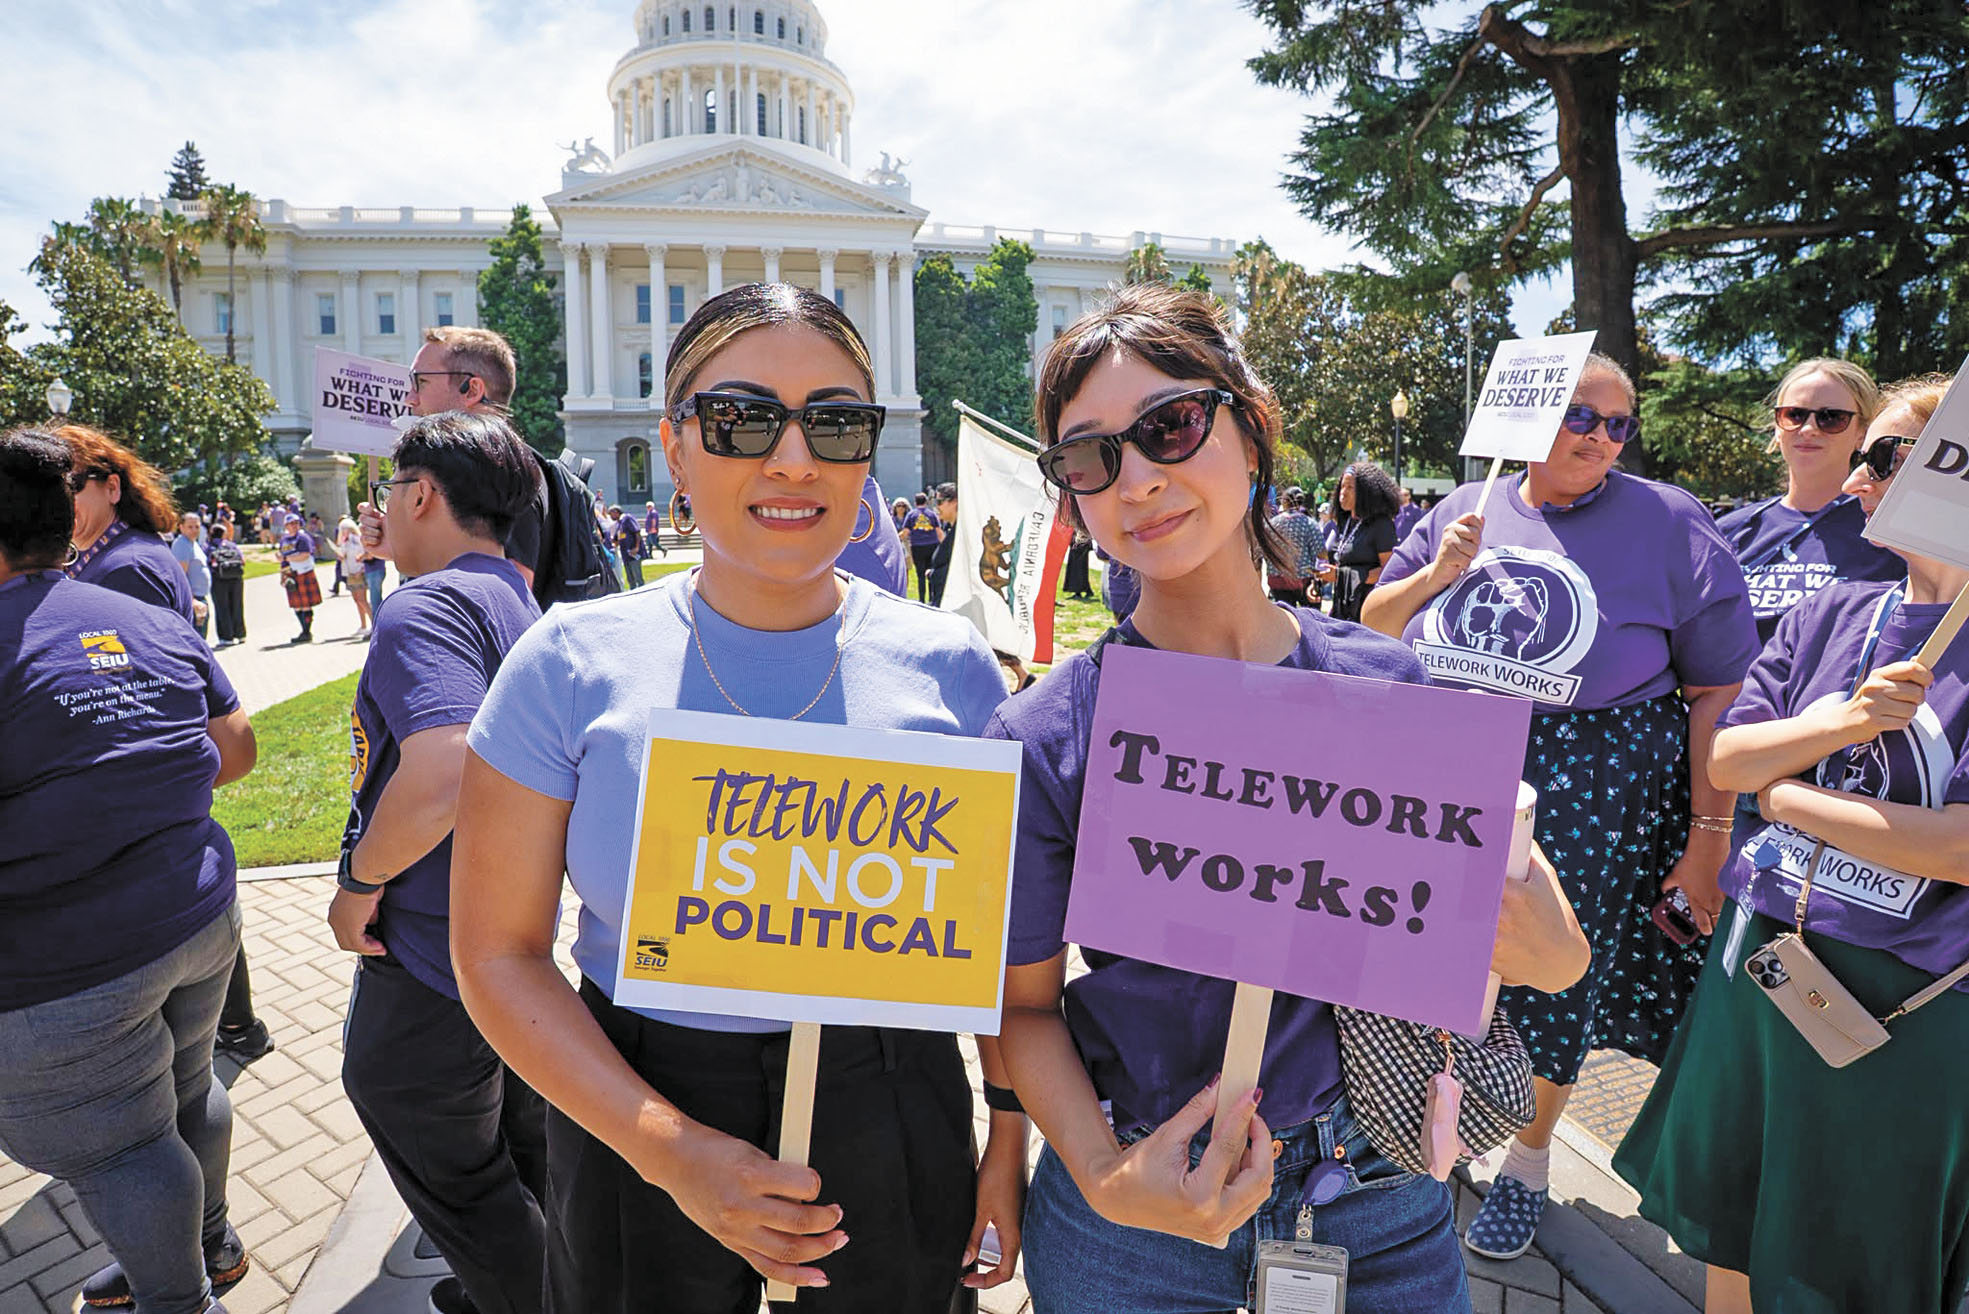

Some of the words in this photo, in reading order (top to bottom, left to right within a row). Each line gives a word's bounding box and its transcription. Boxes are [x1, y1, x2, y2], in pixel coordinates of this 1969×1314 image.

[1508, 356, 1547, 366] FIGHTING
[1548, 354, 1565, 364] FOR
[339, 368, 386, 384] FIGHTING
[388, 378, 405, 386] FOR
[1497, 369, 1539, 385] WHAT
[1543, 367, 1569, 384] WE
[330, 376, 383, 397] WHAT
[1482, 387, 1567, 407] DESERVE
[1805, 563, 1837, 574] FOR
[79, 631, 101, 639] LOCAL
[90, 653, 129, 669] SEIU
[1418, 652, 1490, 677] TELEWORK
[1494, 664, 1564, 697] WORKS
[70, 689, 103, 704] you're
[105, 685, 120, 695] not
[122, 683, 132, 692] at
[132, 680, 147, 690] the
[69, 701, 104, 717] you're
[106, 698, 117, 706] on
[120, 693, 134, 703] the
[92, 714, 115, 725] -Ann
[692, 768, 959, 855] TELEWORK
[692, 836, 757, 896] IS
[786, 845, 955, 912] NOT
[1820, 853, 1905, 899] WORKS
[1127, 836, 1432, 934] works!
[675, 896, 972, 959] POLITICAL
[636, 956, 668, 967] SEIU
